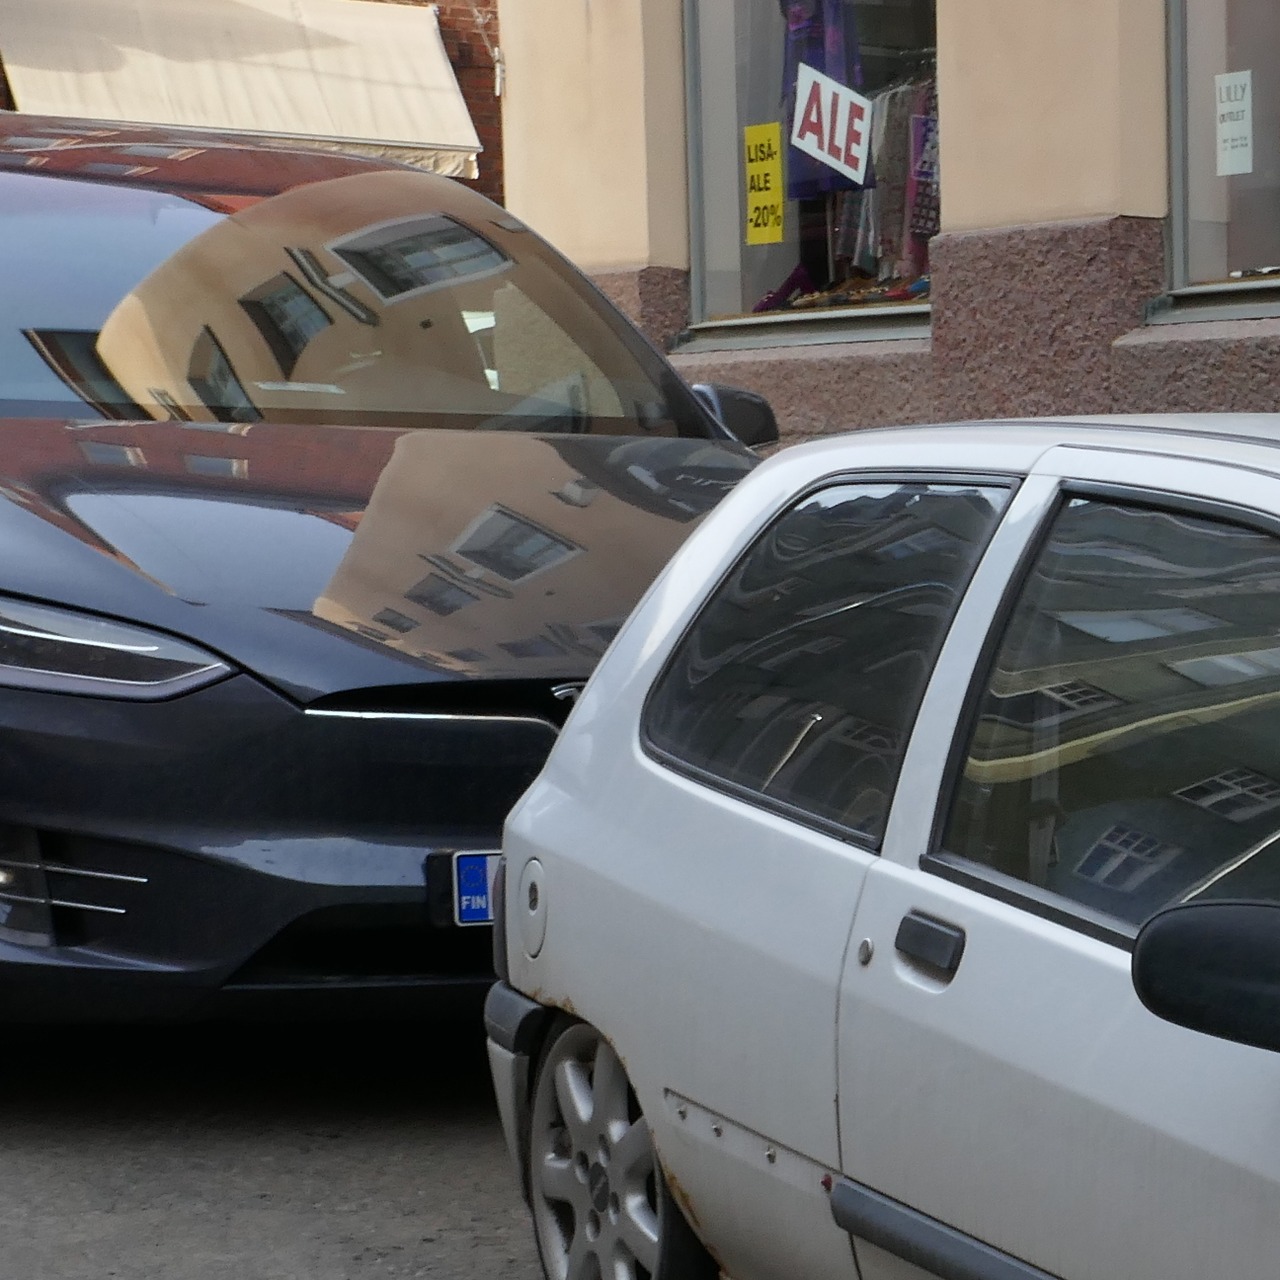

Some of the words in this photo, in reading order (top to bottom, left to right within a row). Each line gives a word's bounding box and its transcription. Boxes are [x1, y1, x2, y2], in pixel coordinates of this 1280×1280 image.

[797, 80, 865, 171] ALE
[749, 172, 771, 192] ALE
[749, 204, 782, 229] -20%
[462, 895, 487, 910] FIN
